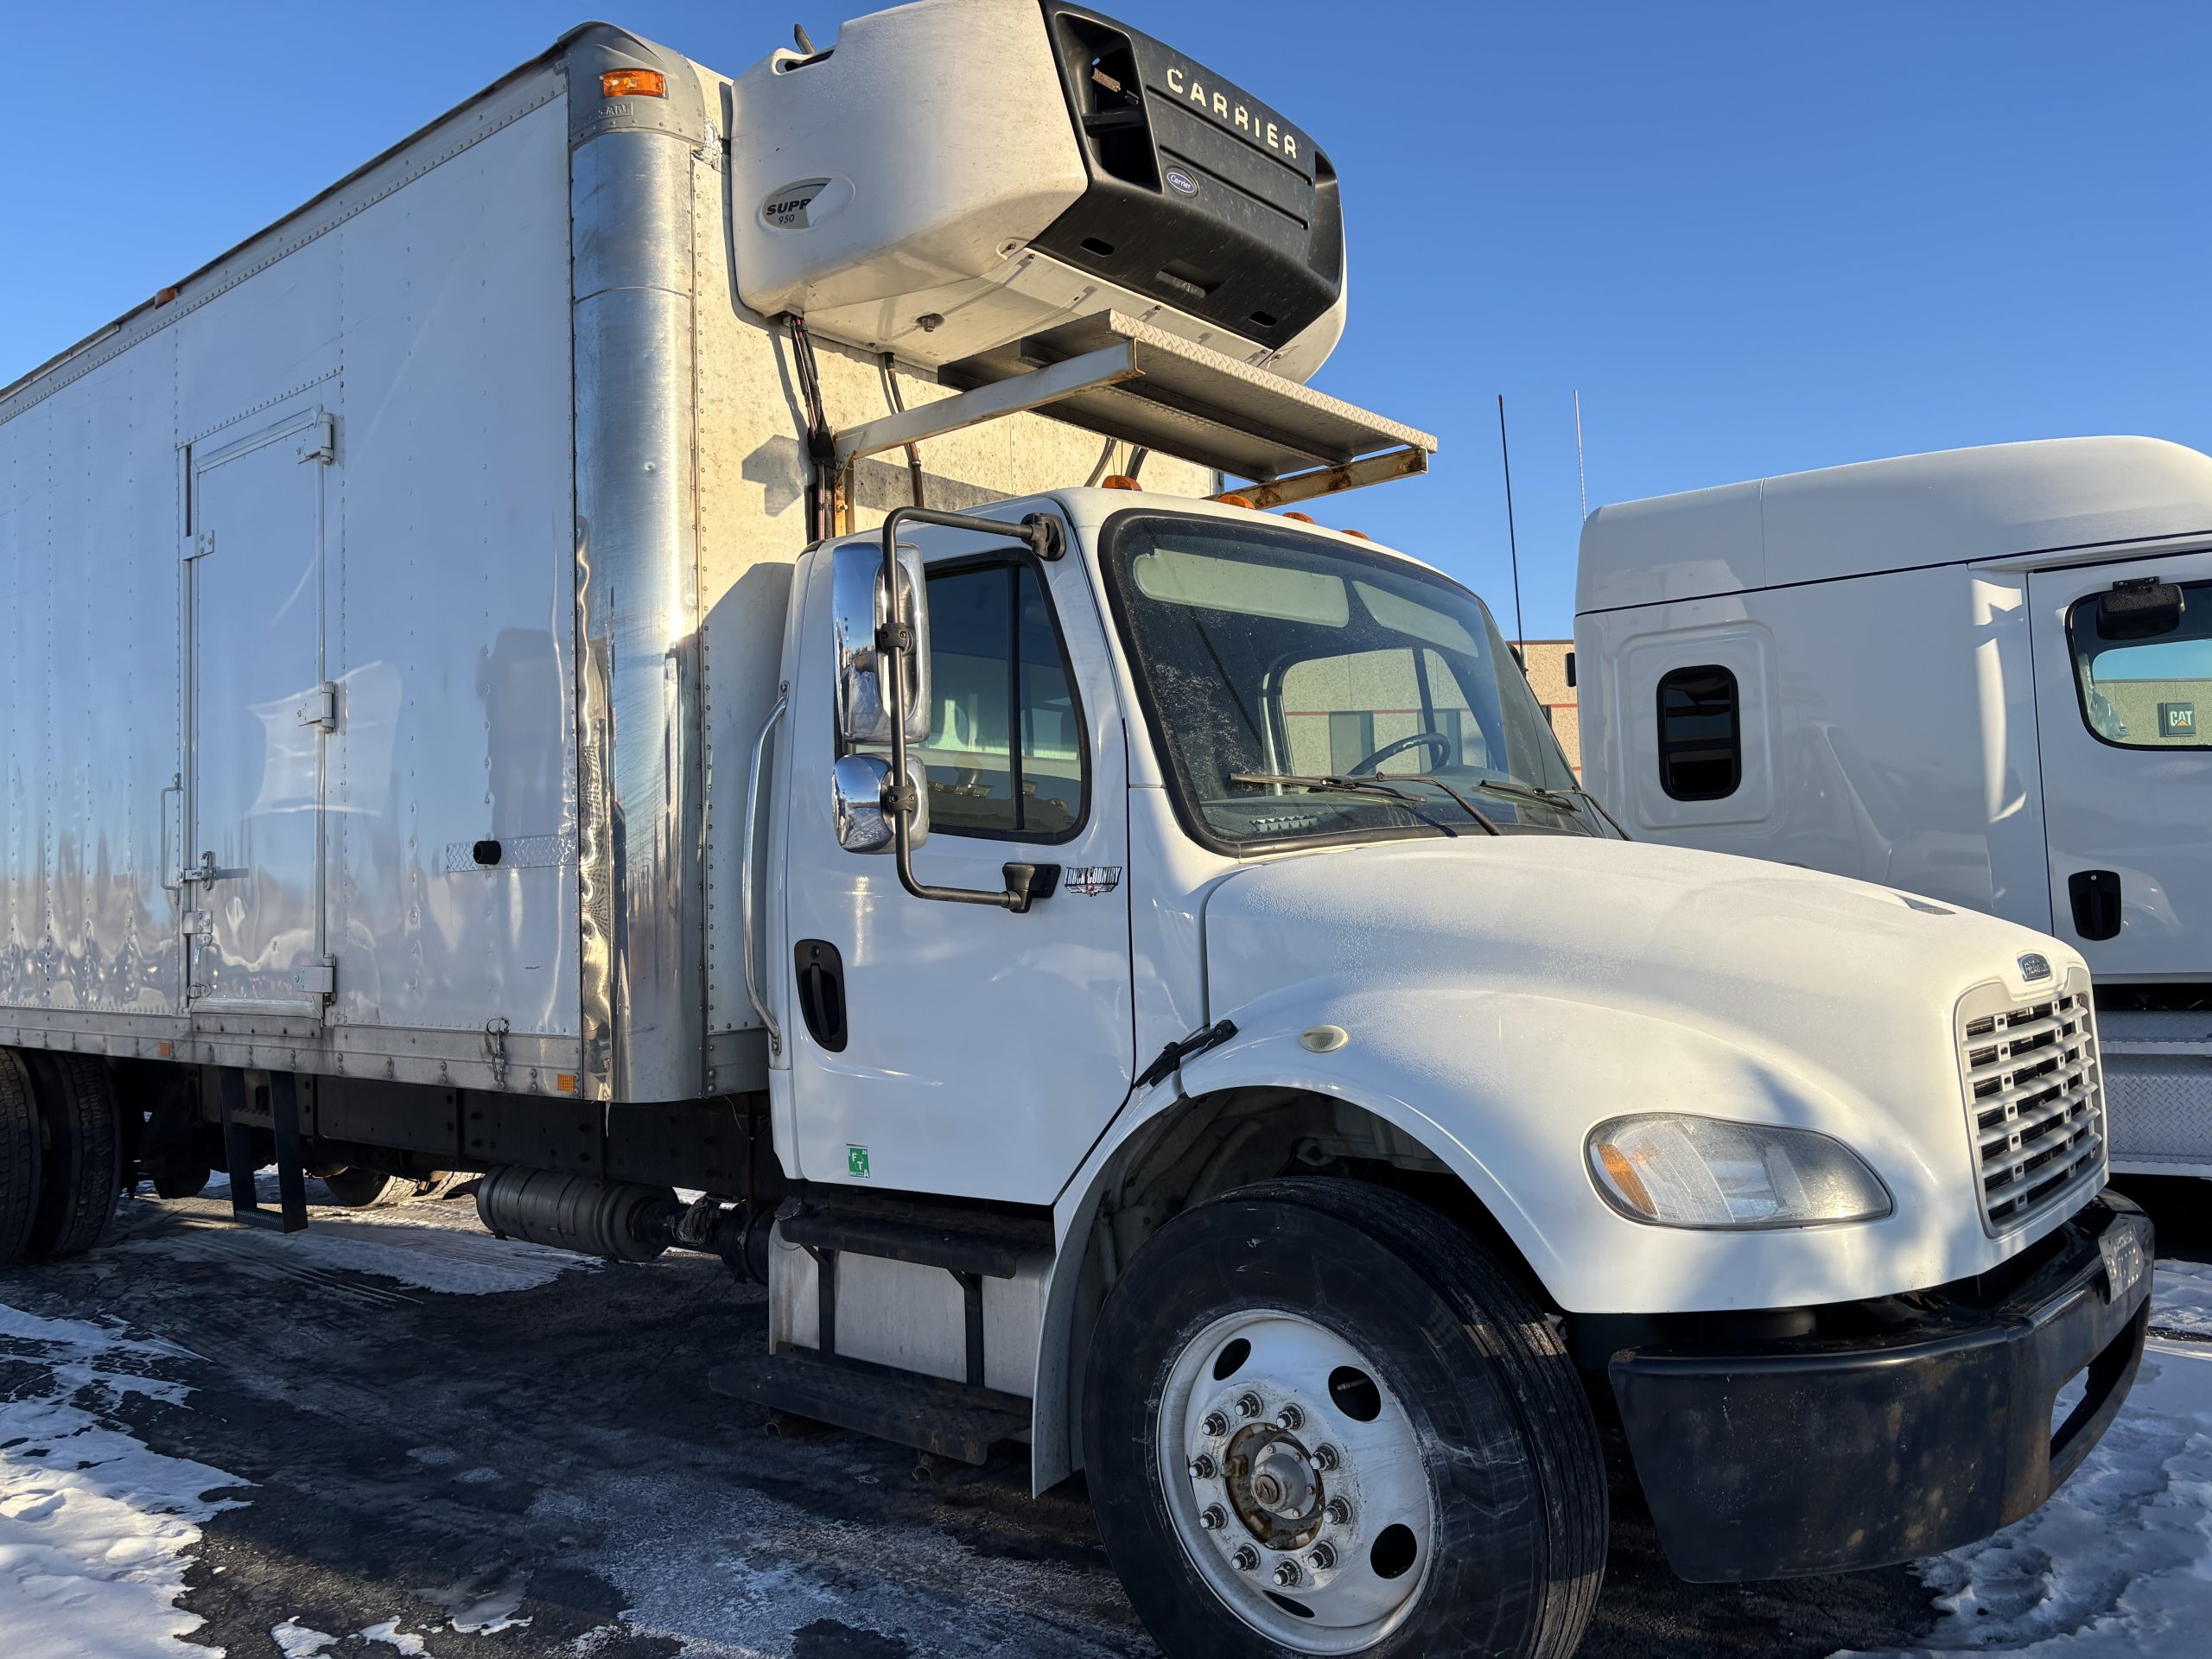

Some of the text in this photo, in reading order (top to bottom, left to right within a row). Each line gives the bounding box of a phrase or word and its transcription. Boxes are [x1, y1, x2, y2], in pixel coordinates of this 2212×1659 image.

[1166, 67, 1298, 159] CARRIER
[1170, 175, 1192, 189] Carrier
[779, 213, 795, 224] 950
[2169, 710, 2193, 727] CAT
[1064, 867, 1122, 885] TRUCK COUNTRY
